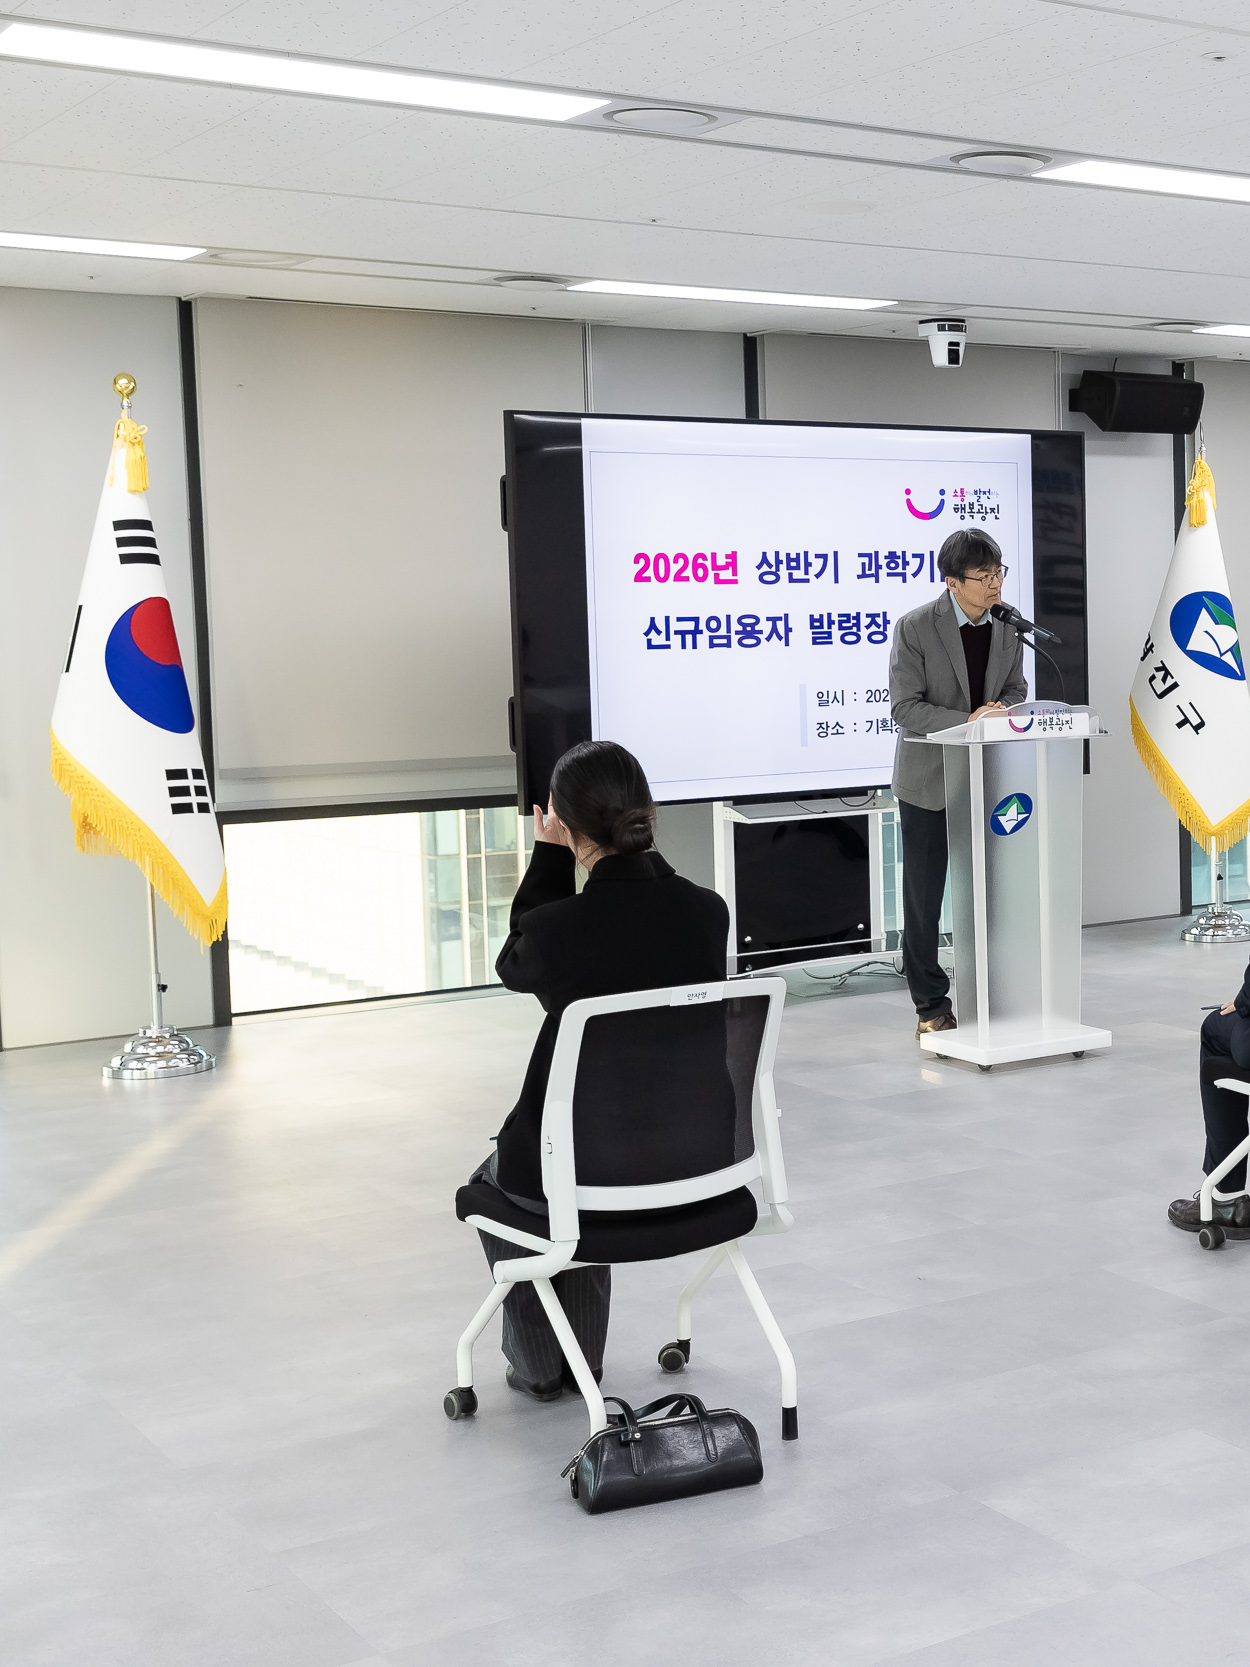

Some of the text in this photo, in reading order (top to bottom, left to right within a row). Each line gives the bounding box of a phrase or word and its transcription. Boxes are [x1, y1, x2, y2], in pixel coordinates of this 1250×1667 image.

[952, 502, 1000, 522] 행복광진
[633, 550, 946, 585] 2026년 상반기 과학기
[643, 611, 891, 650] 신규임용자 발령장
[816, 689, 845, 707] 일시
[865, 688, 890, 703] 202
[816, 721, 845, 738] 장소
[1037, 716, 1073, 732] 행복광진
